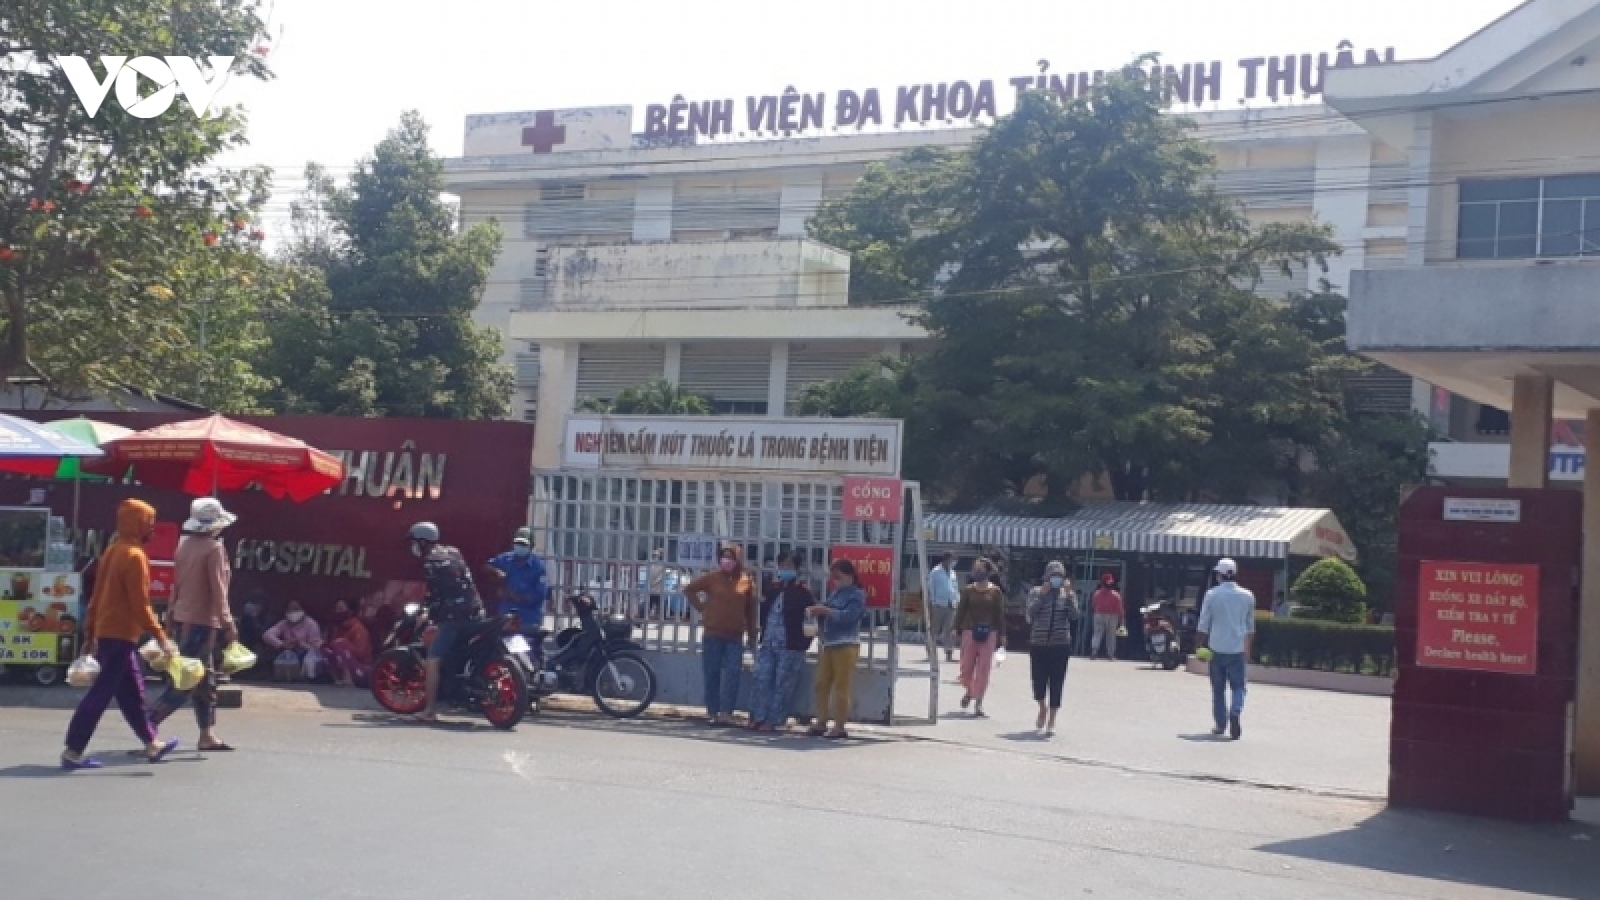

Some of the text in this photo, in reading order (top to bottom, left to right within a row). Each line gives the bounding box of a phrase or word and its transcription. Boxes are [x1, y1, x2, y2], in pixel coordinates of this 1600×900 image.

[747, 85, 825, 137] VIỆN
[837, 88, 882, 127] ĐA
[896, 80, 997, 125] KHOA
[760, 435, 807, 459] TRONG
[809, 432, 850, 465] BỆNH
[853, 433, 889, 467] VIỆN
[233, 537, 373, 579] HOSPITAL
